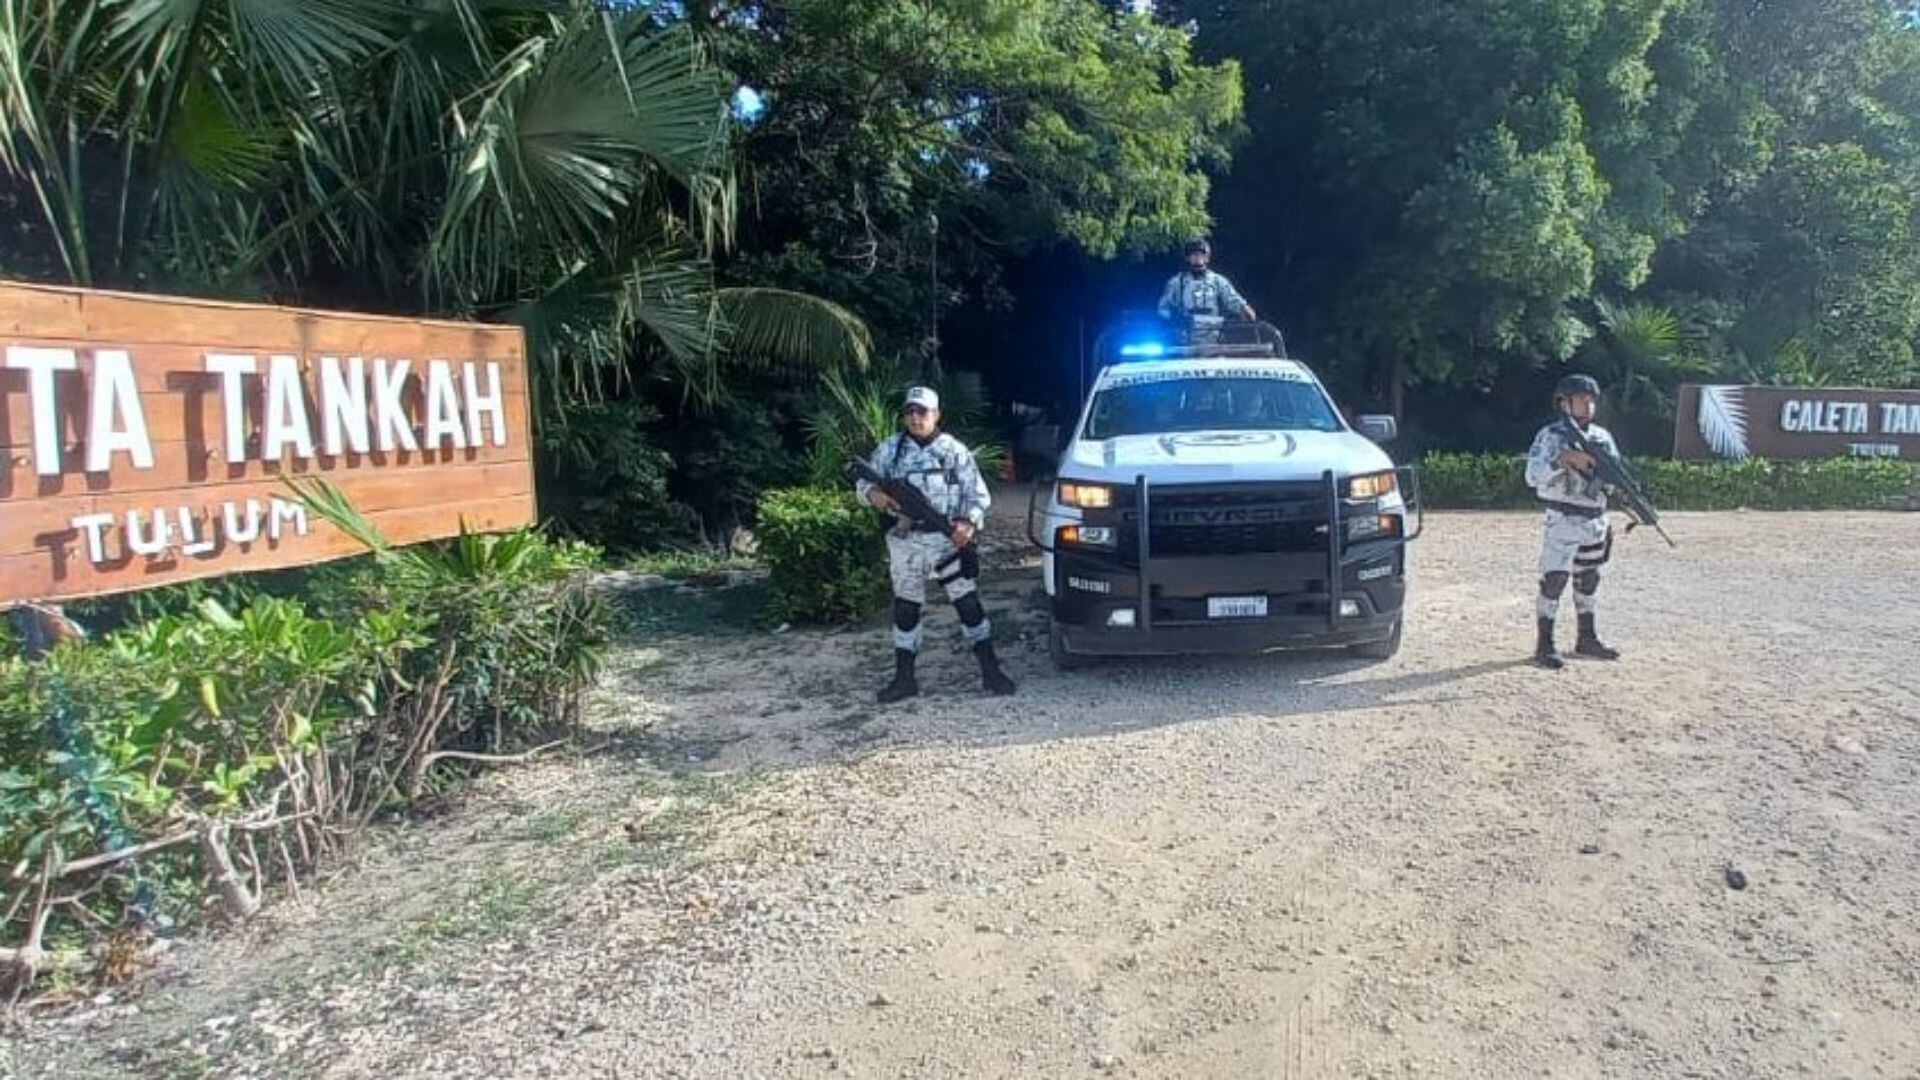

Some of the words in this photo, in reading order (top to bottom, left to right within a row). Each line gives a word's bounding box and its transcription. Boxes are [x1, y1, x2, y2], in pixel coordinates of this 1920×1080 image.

[6, 346, 154, 475] TA
[205, 354, 507, 463] TANKAH
[1780, 399, 1868, 433] CALETA
[71, 498, 308, 562] TULUM
[1122, 507, 1325, 525] CHEVROL
